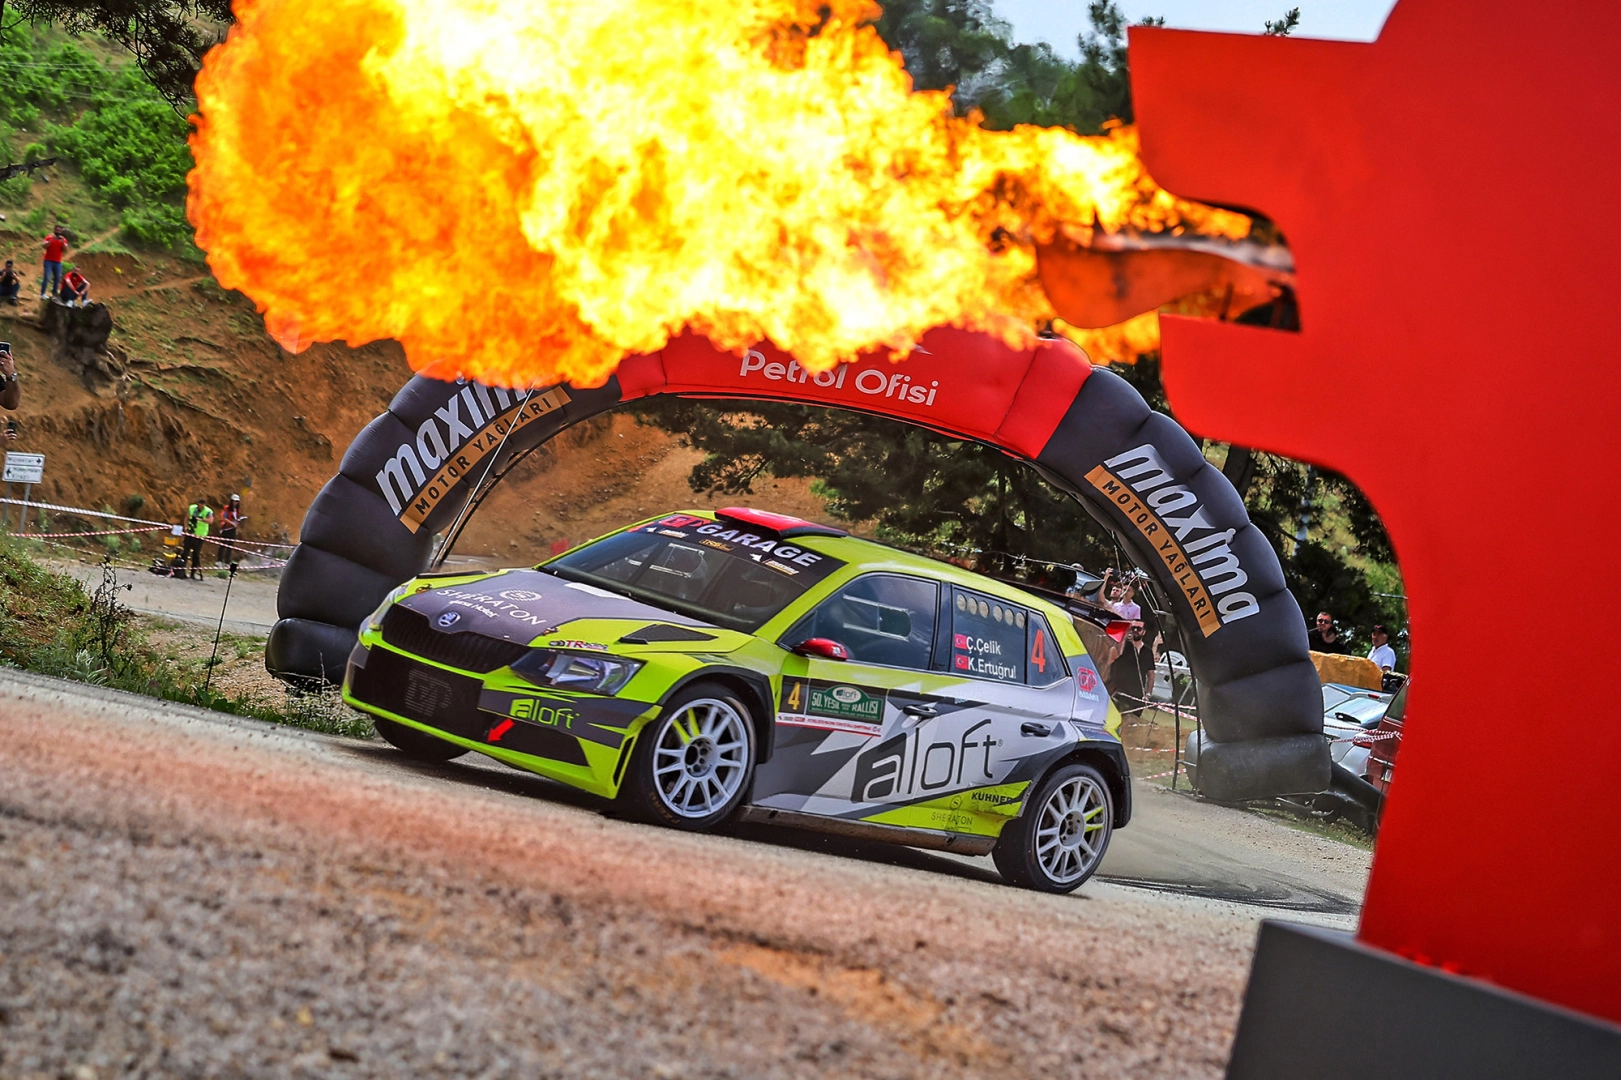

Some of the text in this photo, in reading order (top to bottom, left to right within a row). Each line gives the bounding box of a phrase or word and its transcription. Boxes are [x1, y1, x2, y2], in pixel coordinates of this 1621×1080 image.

[855, 369, 939, 407] Ofisi
[414, 397, 552, 515] MOTOR YAĞLARI
[696, 524, 823, 567] GARAGE
[1102, 480, 1210, 619] MOTOR YAĞLARI
[1103, 443, 1260, 625] maxima
[437, 589, 547, 625] SHERATON
[966, 636, 1002, 655] Ç.Çelik
[1031, 629, 1046, 673] 4
[967, 656, 1017, 679] K.Ertuğrul
[509, 698, 575, 730] aloft
[788, 682, 801, 710] 4
[851, 718, 997, 803] aloft
[931, 812, 973, 825] SHERATON
